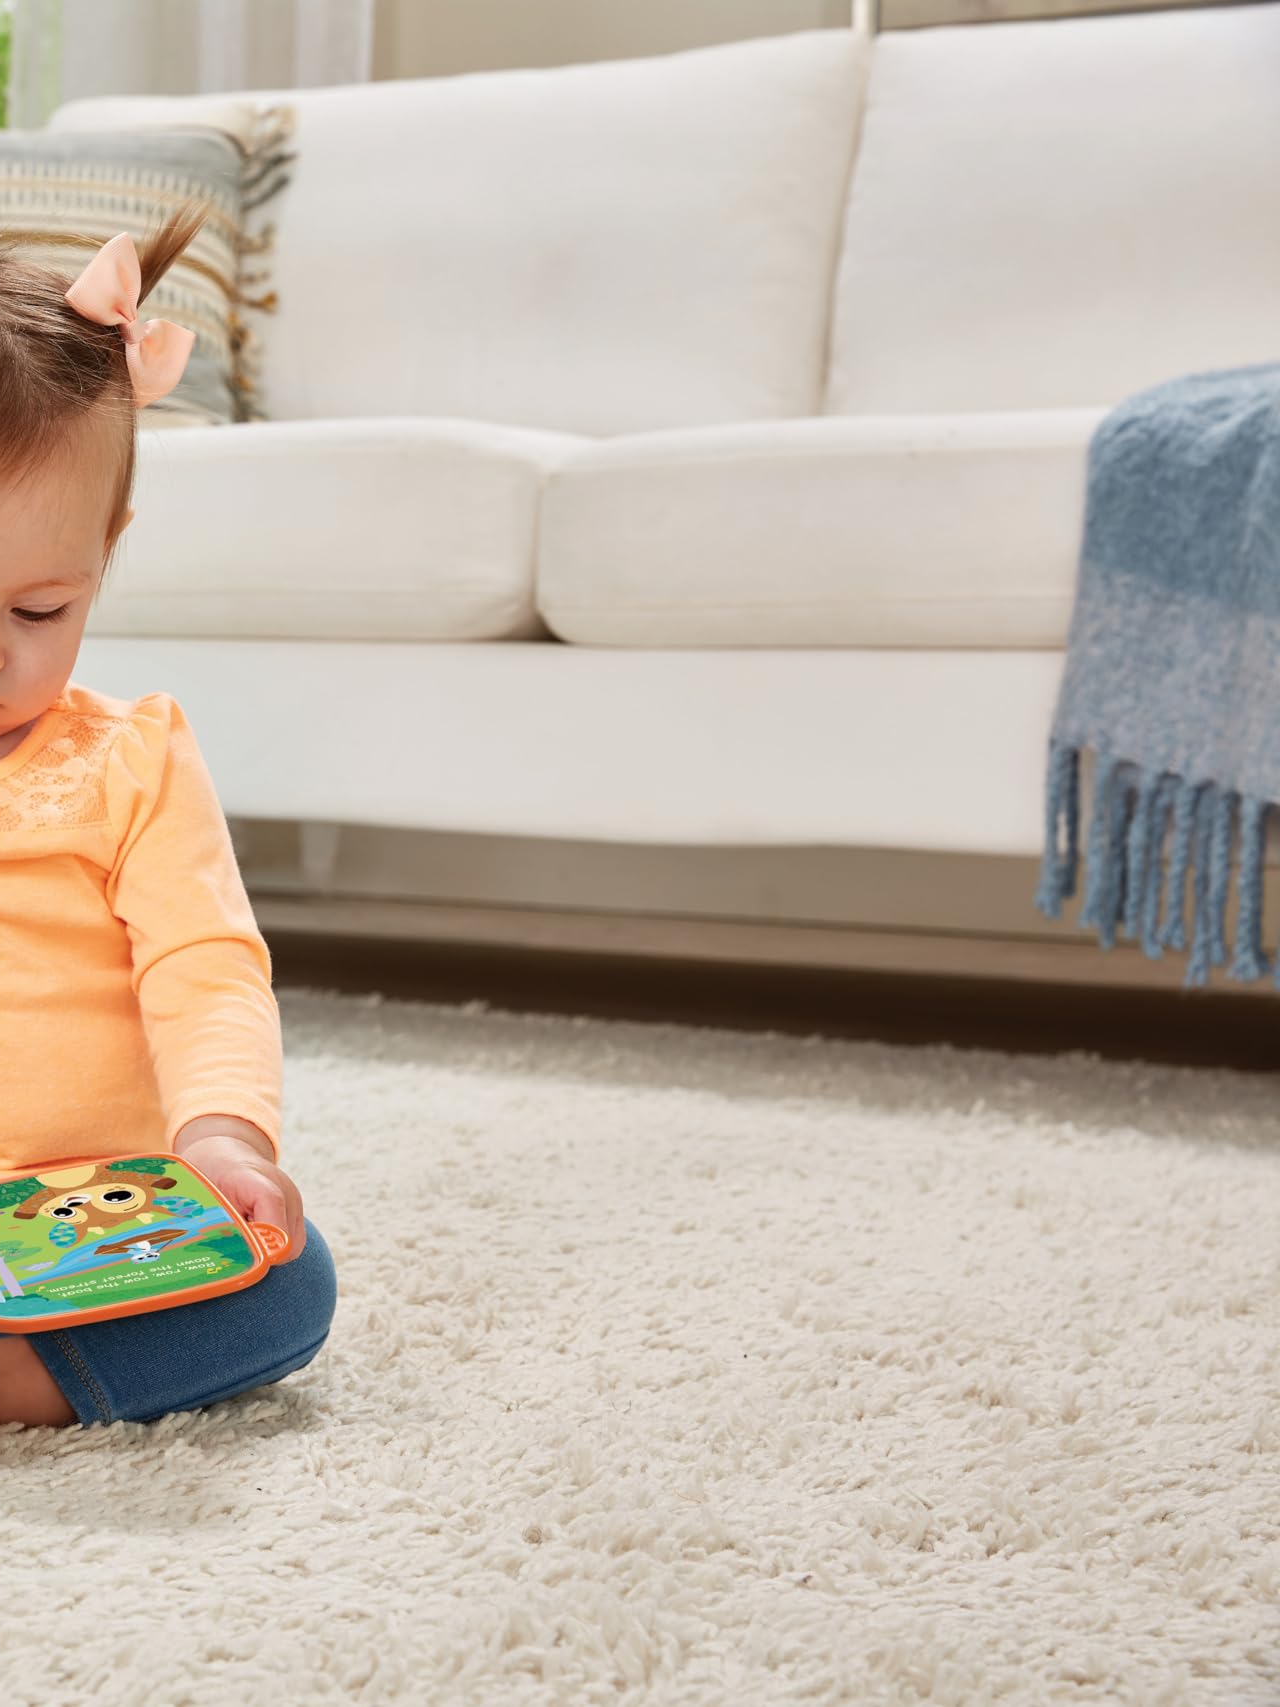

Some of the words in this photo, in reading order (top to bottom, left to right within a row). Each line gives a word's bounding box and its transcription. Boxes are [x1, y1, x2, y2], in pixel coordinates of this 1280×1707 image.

[176, 1256, 211, 1267] down
[149, 1264, 173, 1273] the
[103, 1270, 146, 1283] forest
[124, 1275, 149, 1284] row
[96, 1281, 120, 1290] the
